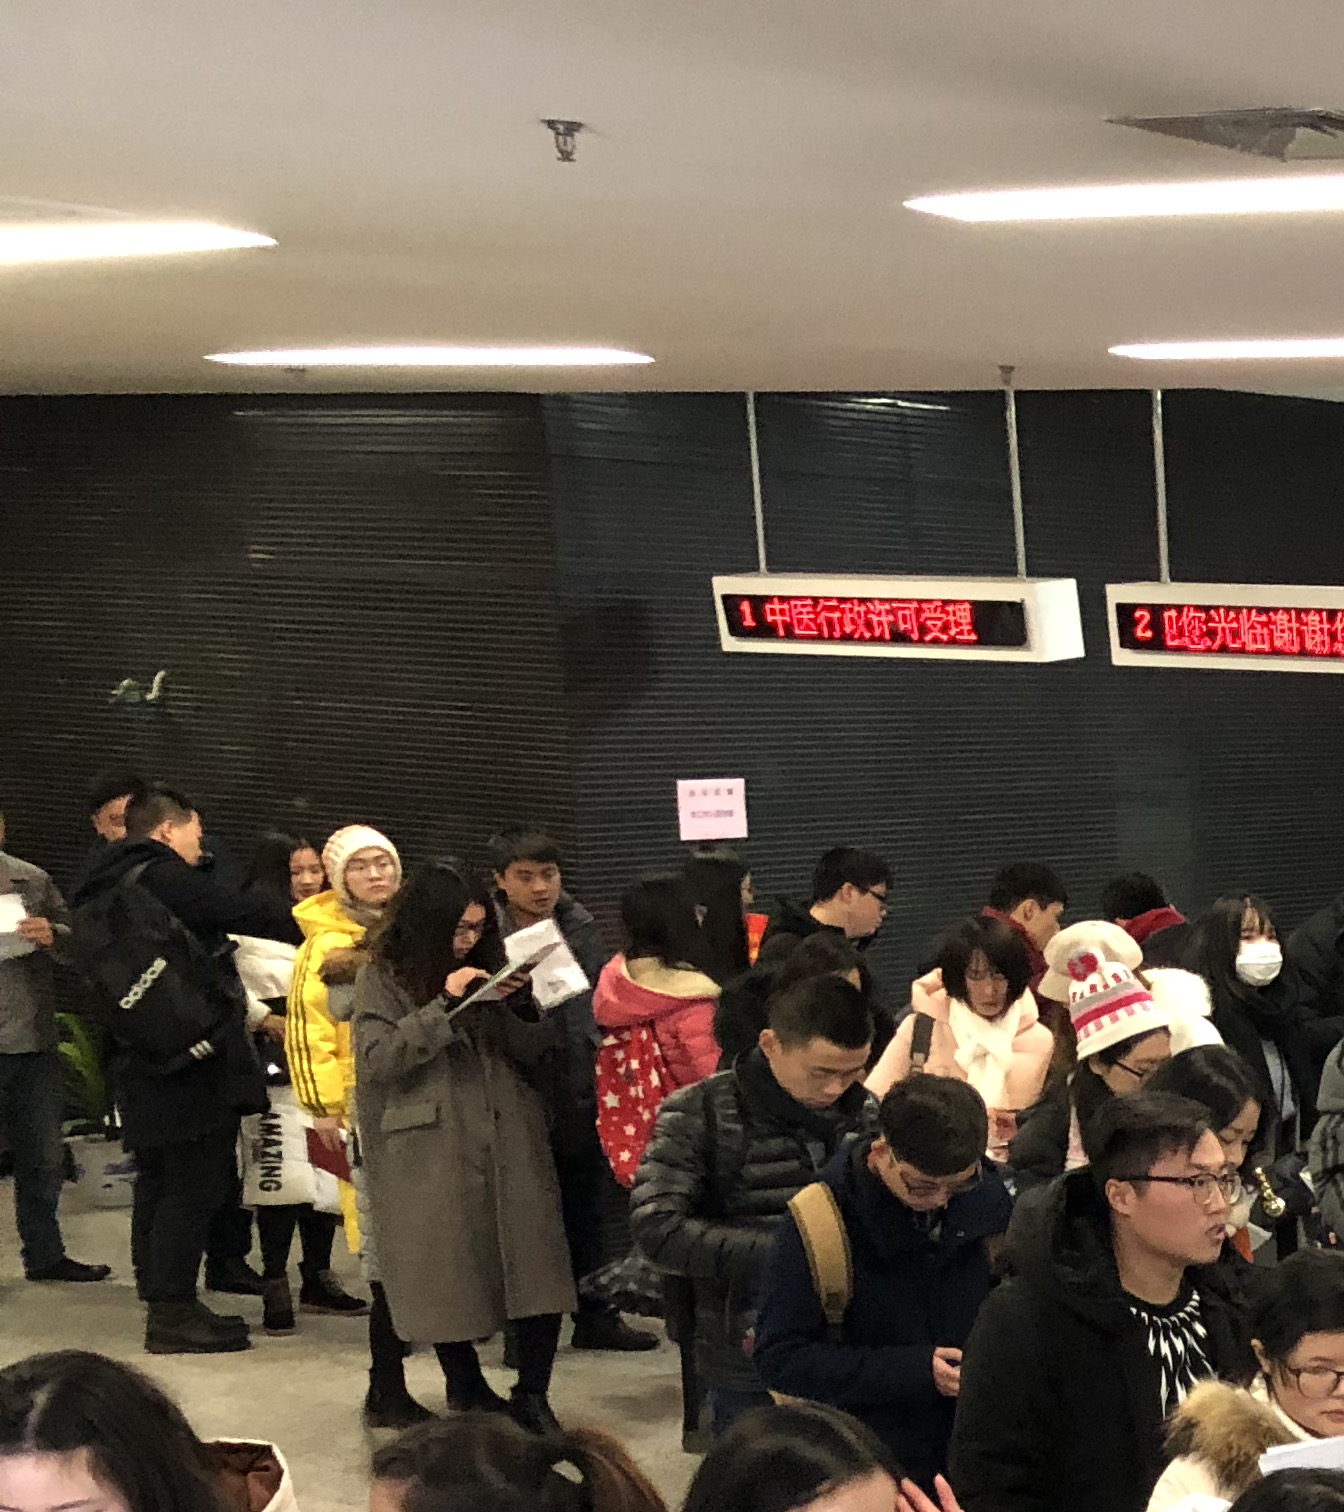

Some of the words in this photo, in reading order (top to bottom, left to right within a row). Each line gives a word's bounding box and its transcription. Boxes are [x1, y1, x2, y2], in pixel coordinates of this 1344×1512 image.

[739, 600, 756, 627] 1
[764, 597, 978, 643] 中医行政许可受理
[1133, 608, 1153, 640] 2
[119, 956, 168, 1010] adidas
